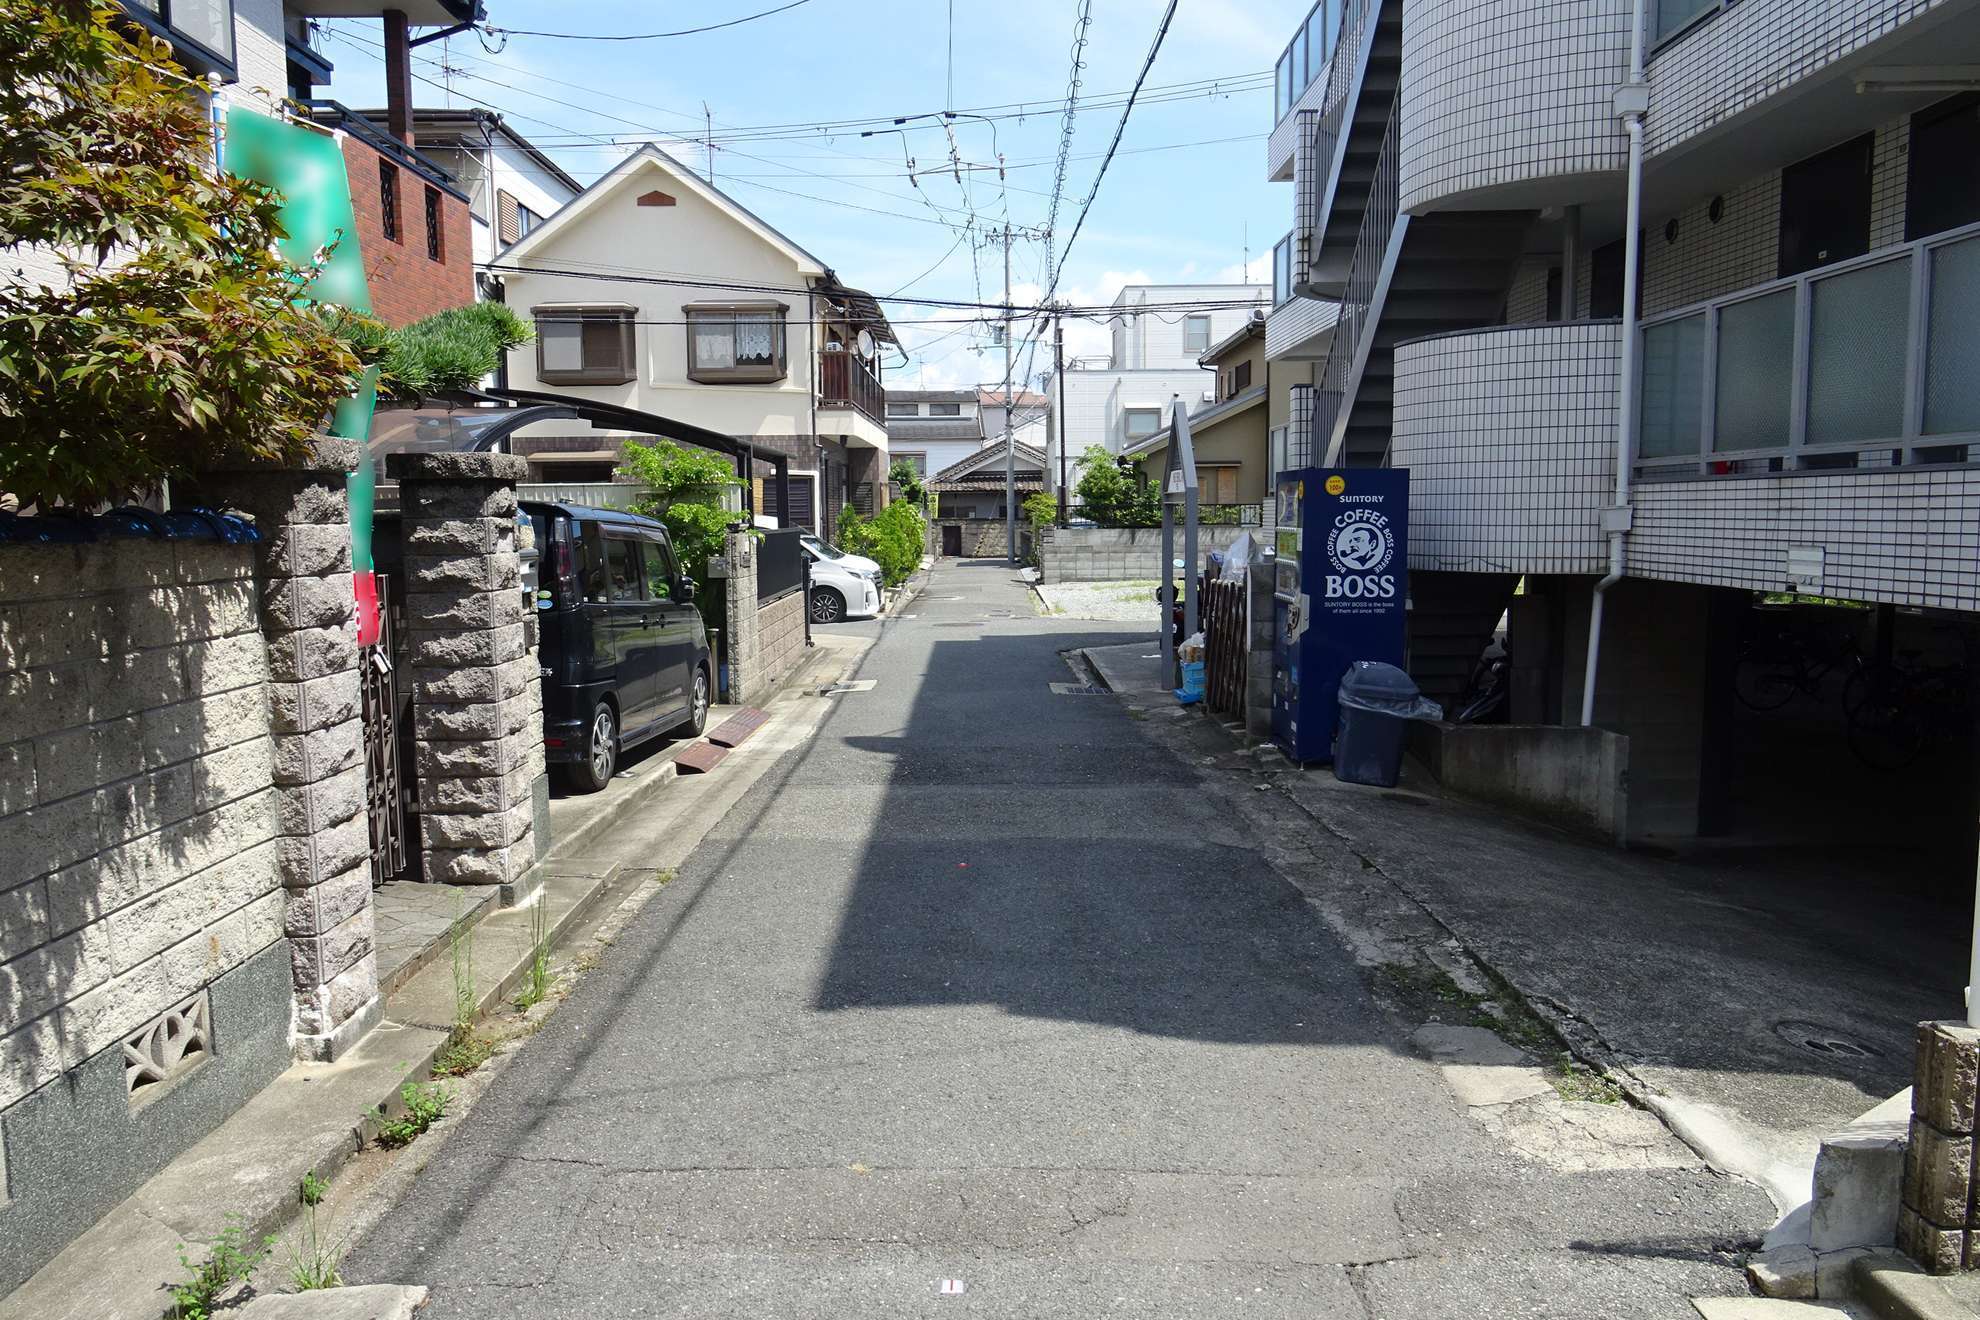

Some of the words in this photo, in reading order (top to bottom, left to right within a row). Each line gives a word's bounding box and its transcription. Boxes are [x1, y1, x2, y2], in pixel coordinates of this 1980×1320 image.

[1339, 495, 1385, 503] SUNTORY
[1335, 509, 1388, 528] COFFEE
[1327, 528, 1339, 556] COFFEE
[1383, 528, 1394, 548] BOSS
[1330, 556, 1347, 574] BOSS
[1373, 549, 1393, 574] COFFEE
[1324, 575, 1395, 598] BOSS
